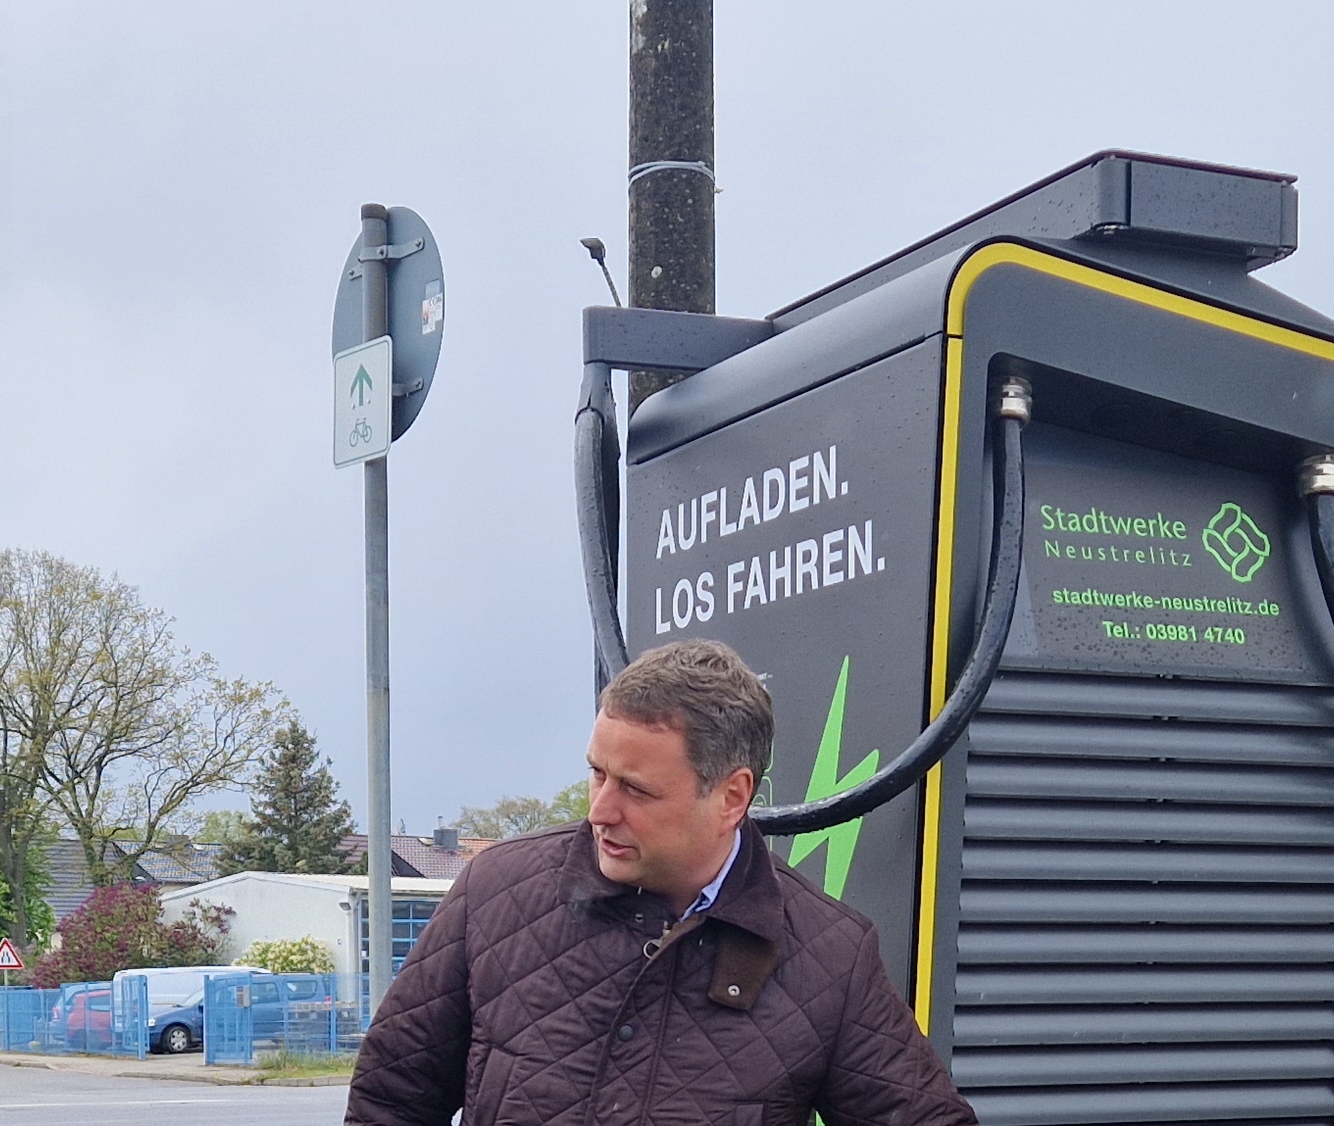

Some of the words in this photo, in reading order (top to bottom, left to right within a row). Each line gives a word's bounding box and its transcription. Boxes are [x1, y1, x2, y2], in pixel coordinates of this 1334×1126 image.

[655, 444, 849, 560] AUFLADEN.
[1040, 504, 1188, 540] Stadtwerke
[1043, 540, 1192, 567] Neustrelitz
[655, 571, 715, 635] LOS
[727, 519, 886, 614] FAHREN.
[1052, 587, 1281, 616] stadtwerke-neustrelitz.de
[1101, 620, 1141, 639] Tel.:
[1145, 623, 1198, 642] 03981
[1203, 627, 1246, 645] 4740
